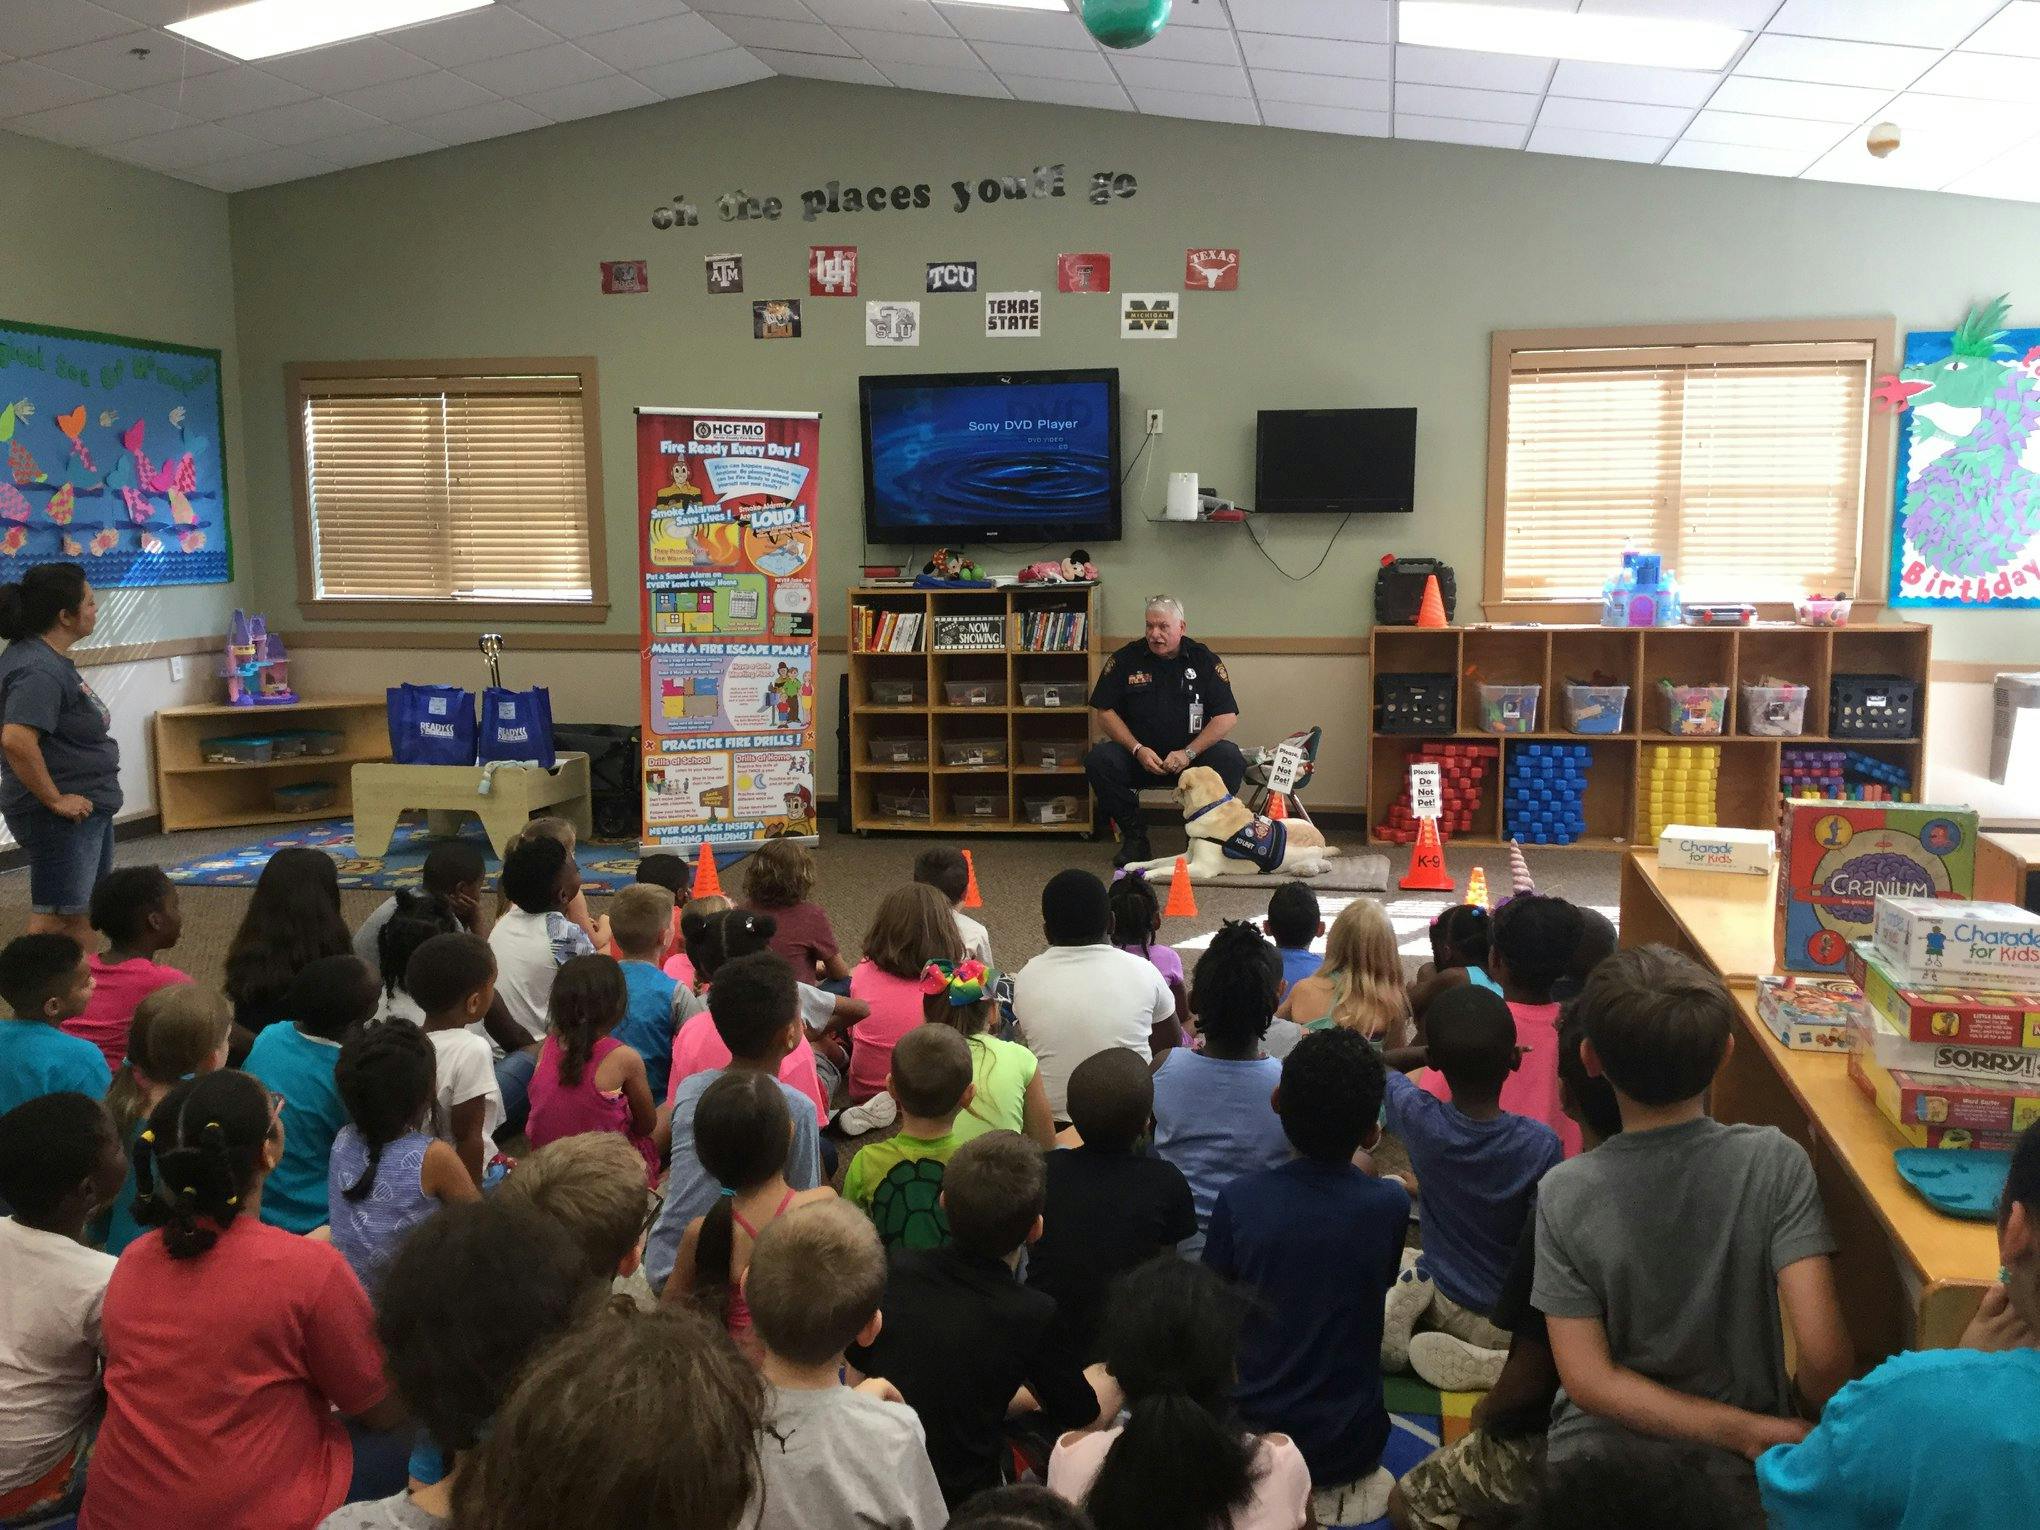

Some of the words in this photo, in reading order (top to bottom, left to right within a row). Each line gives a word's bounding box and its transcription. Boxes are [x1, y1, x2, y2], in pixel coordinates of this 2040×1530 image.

[801, 180, 931, 223] places
[1090, 171, 1138, 206] go
[1190, 250, 1237, 265] TEXAS
[929, 264, 975, 289] TCU
[988, 300, 1039, 314] TEXAS
[1130, 311, 1169, 319] MICHIGAN
[988, 315, 1039, 331] STATE
[712, 424, 764, 436] HCFMO
[968, 422, 1000, 432] Sony
[1004, 420, 1032, 430] DVD
[1038, 420, 1078, 430] Player
[660, 440, 686, 454] Fire
[688, 441, 729, 456] Ready
[731, 442, 765, 458] Every
[768, 443, 793, 458] Day
[651, 508, 685, 518] Smoke
[686, 504, 721, 515] Alarms
[738, 504, 761, 513] Smoke
[676, 515, 700, 526] Save
[701, 512, 725, 523] Lives
[751, 508, 795, 528] LOUD
[671, 580, 690, 588] Level
[968, 623, 990, 632] NOW
[959, 633, 1000, 643] SHOWING
[651, 643, 684, 654] MAKE
[687, 643, 697, 654] A
[700, 643, 724, 654] FIRE
[726, 644, 770, 655] ESCAPE
[772, 645, 802, 656] PLAN
[662, 738, 723, 750] PRACTICE
[726, 736, 751, 748] FIRE
[754, 734, 793, 747] DRILLS
[649, 758, 671, 767] Drills
[672, 757, 680, 766] at
[682, 756, 710, 765] School
[736, 754, 757, 763] Drills
[758, 754, 767, 762] at
[768, 753, 791, 761] Home
[1278, 766, 1291, 775] Not
[1274, 775, 1290, 784] Pet!
[649, 826, 679, 835] NEVER
[681, 825, 696, 833] GO
[698, 823, 723, 832] BACK
[725, 821, 755, 831] INSIDE
[661, 836, 702, 844] BURNING
[704, 832, 748, 841] BUILDING
[1418, 855, 1440, 868] K-9
[1689, 852, 1705, 862] for
[1707, 854, 1732, 864] Kids
[1970, 943, 1996, 959] for
[2000, 946, 2040, 962] Kids
[1938, 1048, 2033, 1074] SORRY!
